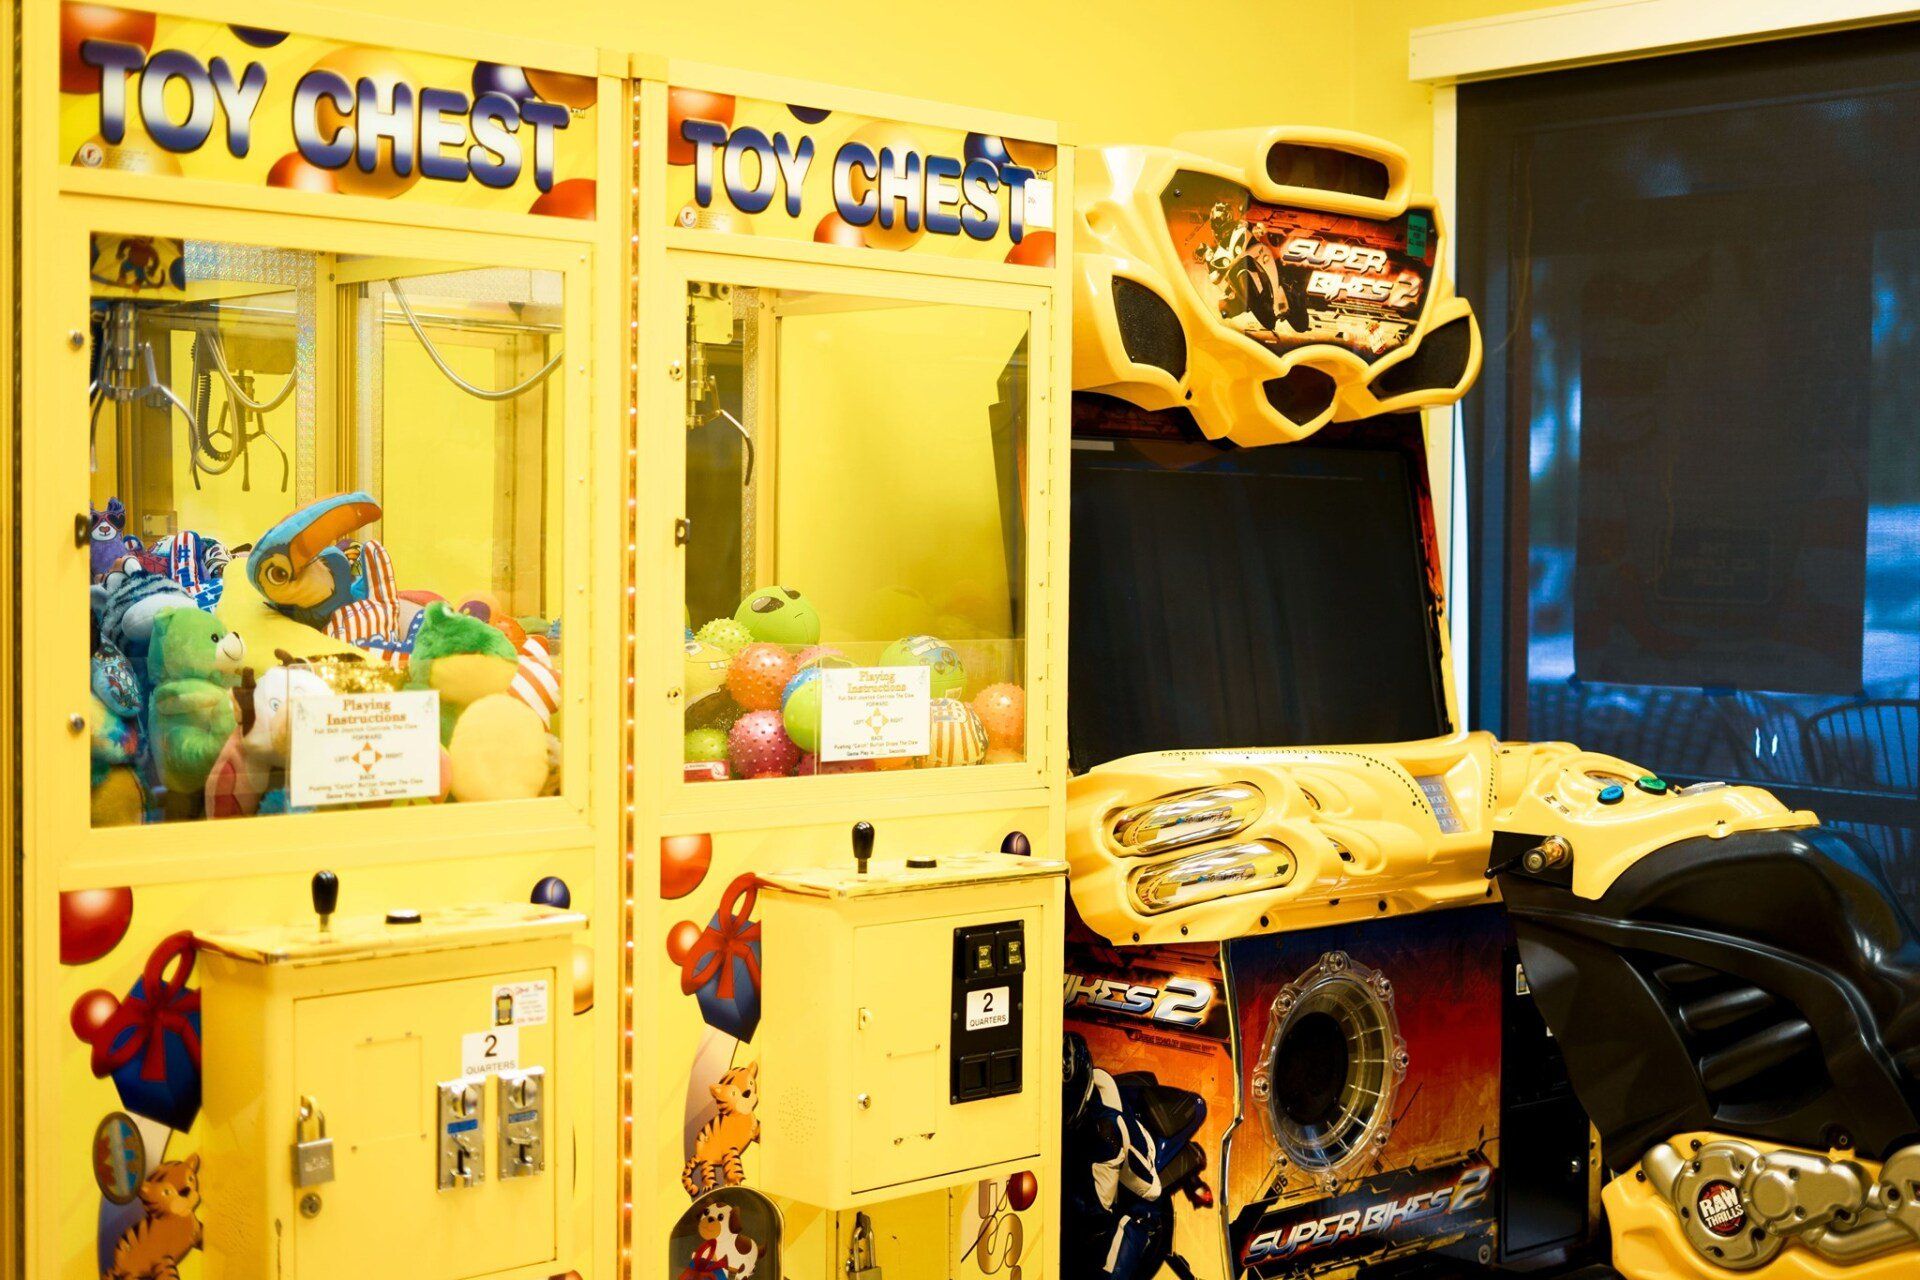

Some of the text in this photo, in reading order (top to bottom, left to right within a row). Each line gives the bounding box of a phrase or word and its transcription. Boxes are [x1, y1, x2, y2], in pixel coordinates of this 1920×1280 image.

[81, 38, 267, 158] TOY
[293, 70, 570, 193] CHEST
[681, 118, 815, 218] TOY
[832, 142, 1037, 244] CHEST
[1283, 238, 1387, 273] SUPER
[1307, 270, 1421, 307] BIKES 2
[848, 683, 906, 694] Instructions
[859, 670, 896, 683] Playing
[343, 698, 391, 714] Playing
[327, 711, 406, 726] Instructions
[983, 992, 994, 1013] 2
[1063, 973, 1212, 1030] IKES 2
[970, 1014, 1006, 1028] QUARTERS
[484, 1034, 498, 1058] 2
[466, 1060, 516, 1076] QUARTERS
[1243, 1166, 1493, 1262] SUPER BIKES 2
[1699, 1187, 1739, 1218] RAW
[1705, 1204, 1744, 1228] THRILLS
